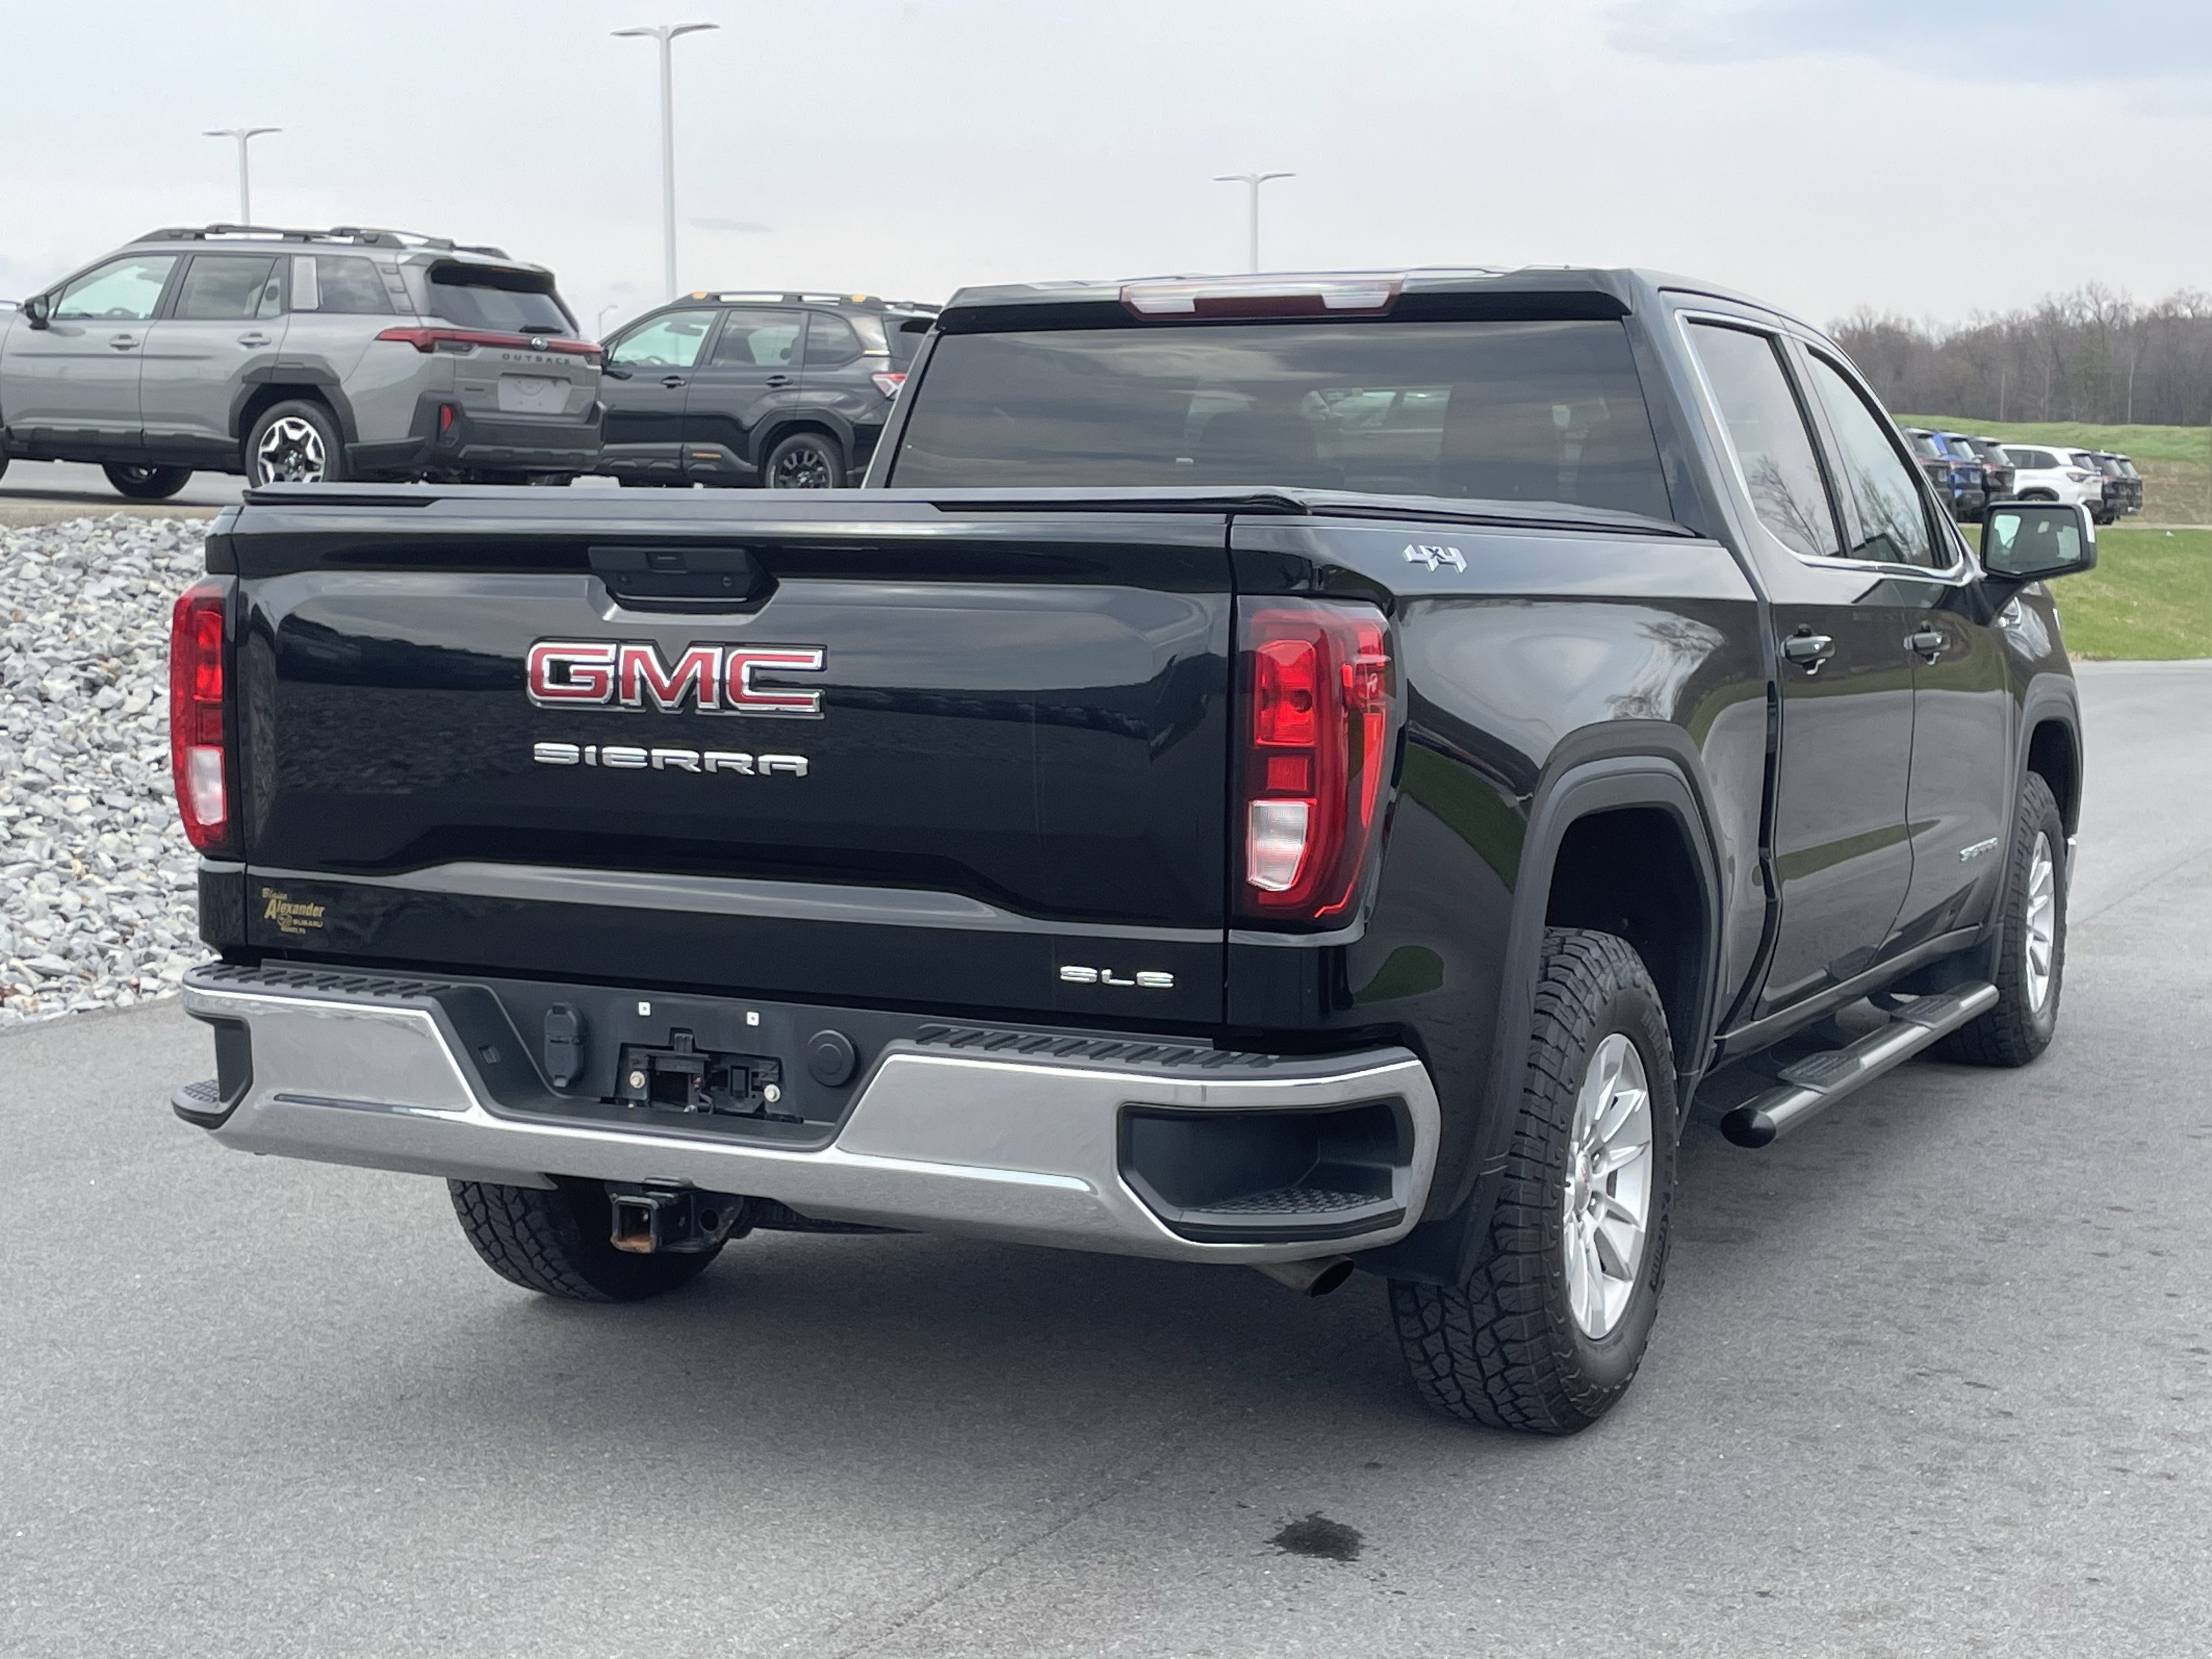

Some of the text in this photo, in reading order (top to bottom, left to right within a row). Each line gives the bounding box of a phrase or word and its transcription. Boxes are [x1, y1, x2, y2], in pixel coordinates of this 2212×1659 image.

[502, 353, 571, 365] OUTBACK
[526, 639, 826, 718] GMC
[534, 742, 809, 777] SIERRA
[264, 898, 325, 919] Alexander
[1060, 966, 1174, 988] SLE
